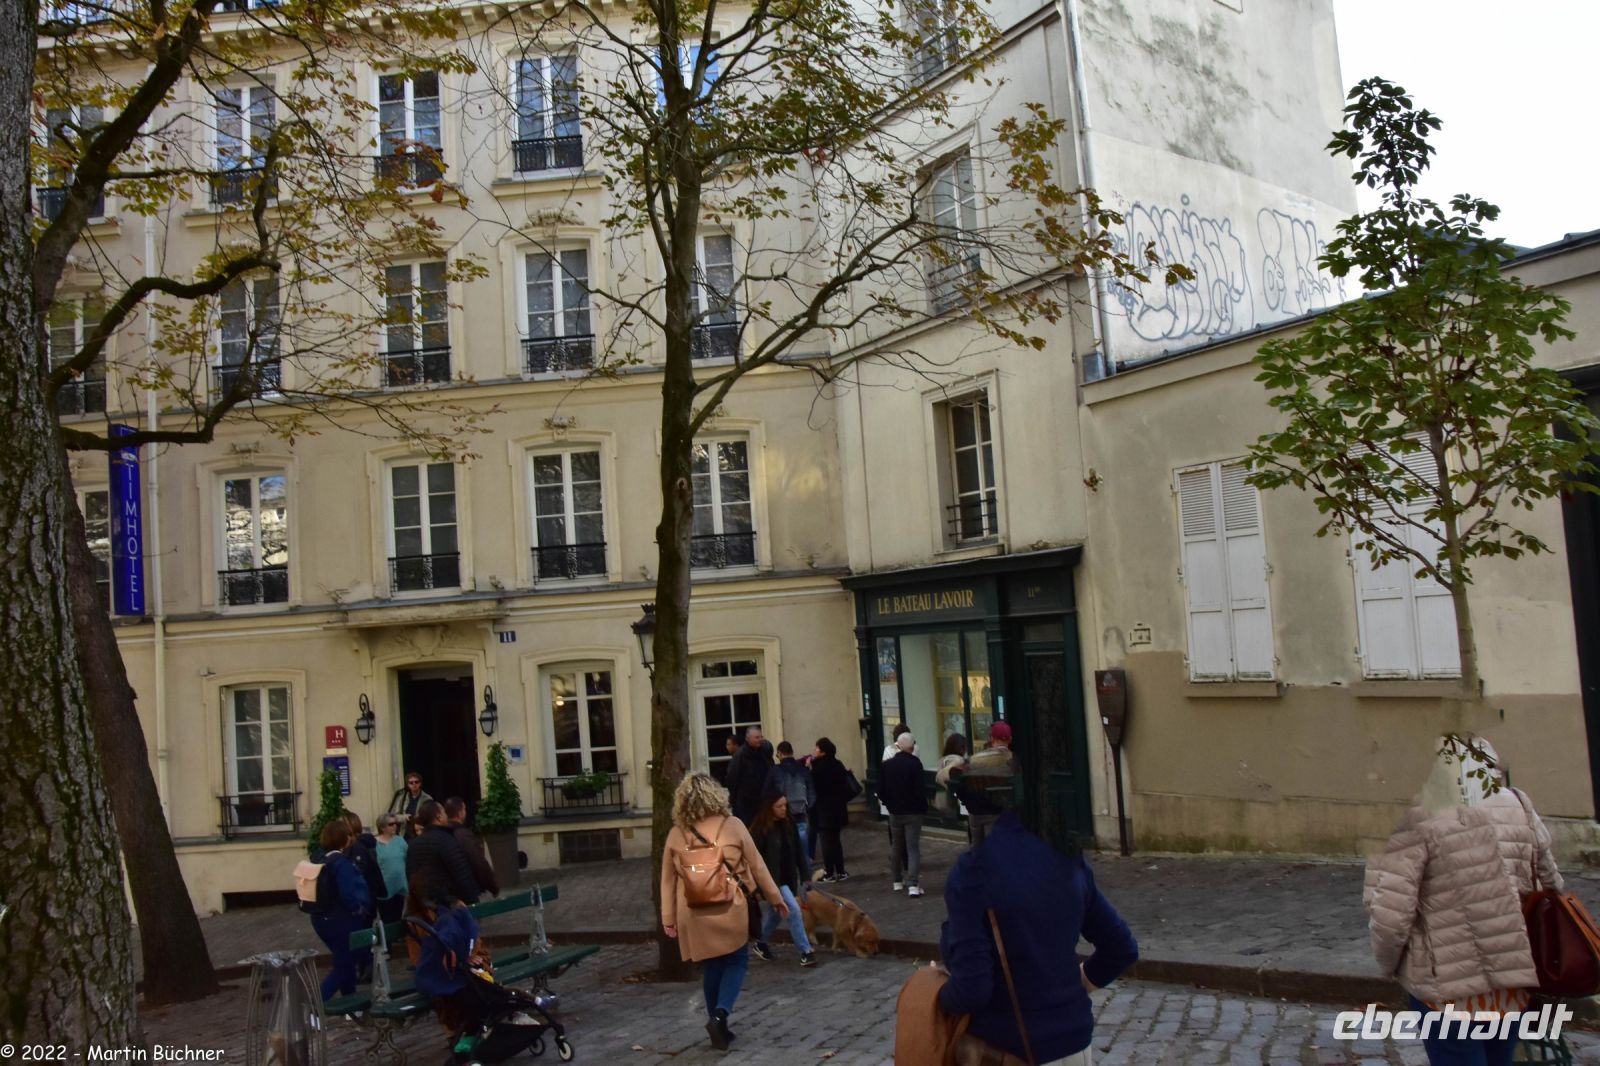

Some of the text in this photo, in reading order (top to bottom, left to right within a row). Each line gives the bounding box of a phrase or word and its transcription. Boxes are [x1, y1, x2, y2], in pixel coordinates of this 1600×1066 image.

[125, 463, 139, 611] TIMHOTEL
[878, 589, 974, 615] LE BATEAU LAVOIR
[335, 729, 344, 738] H
